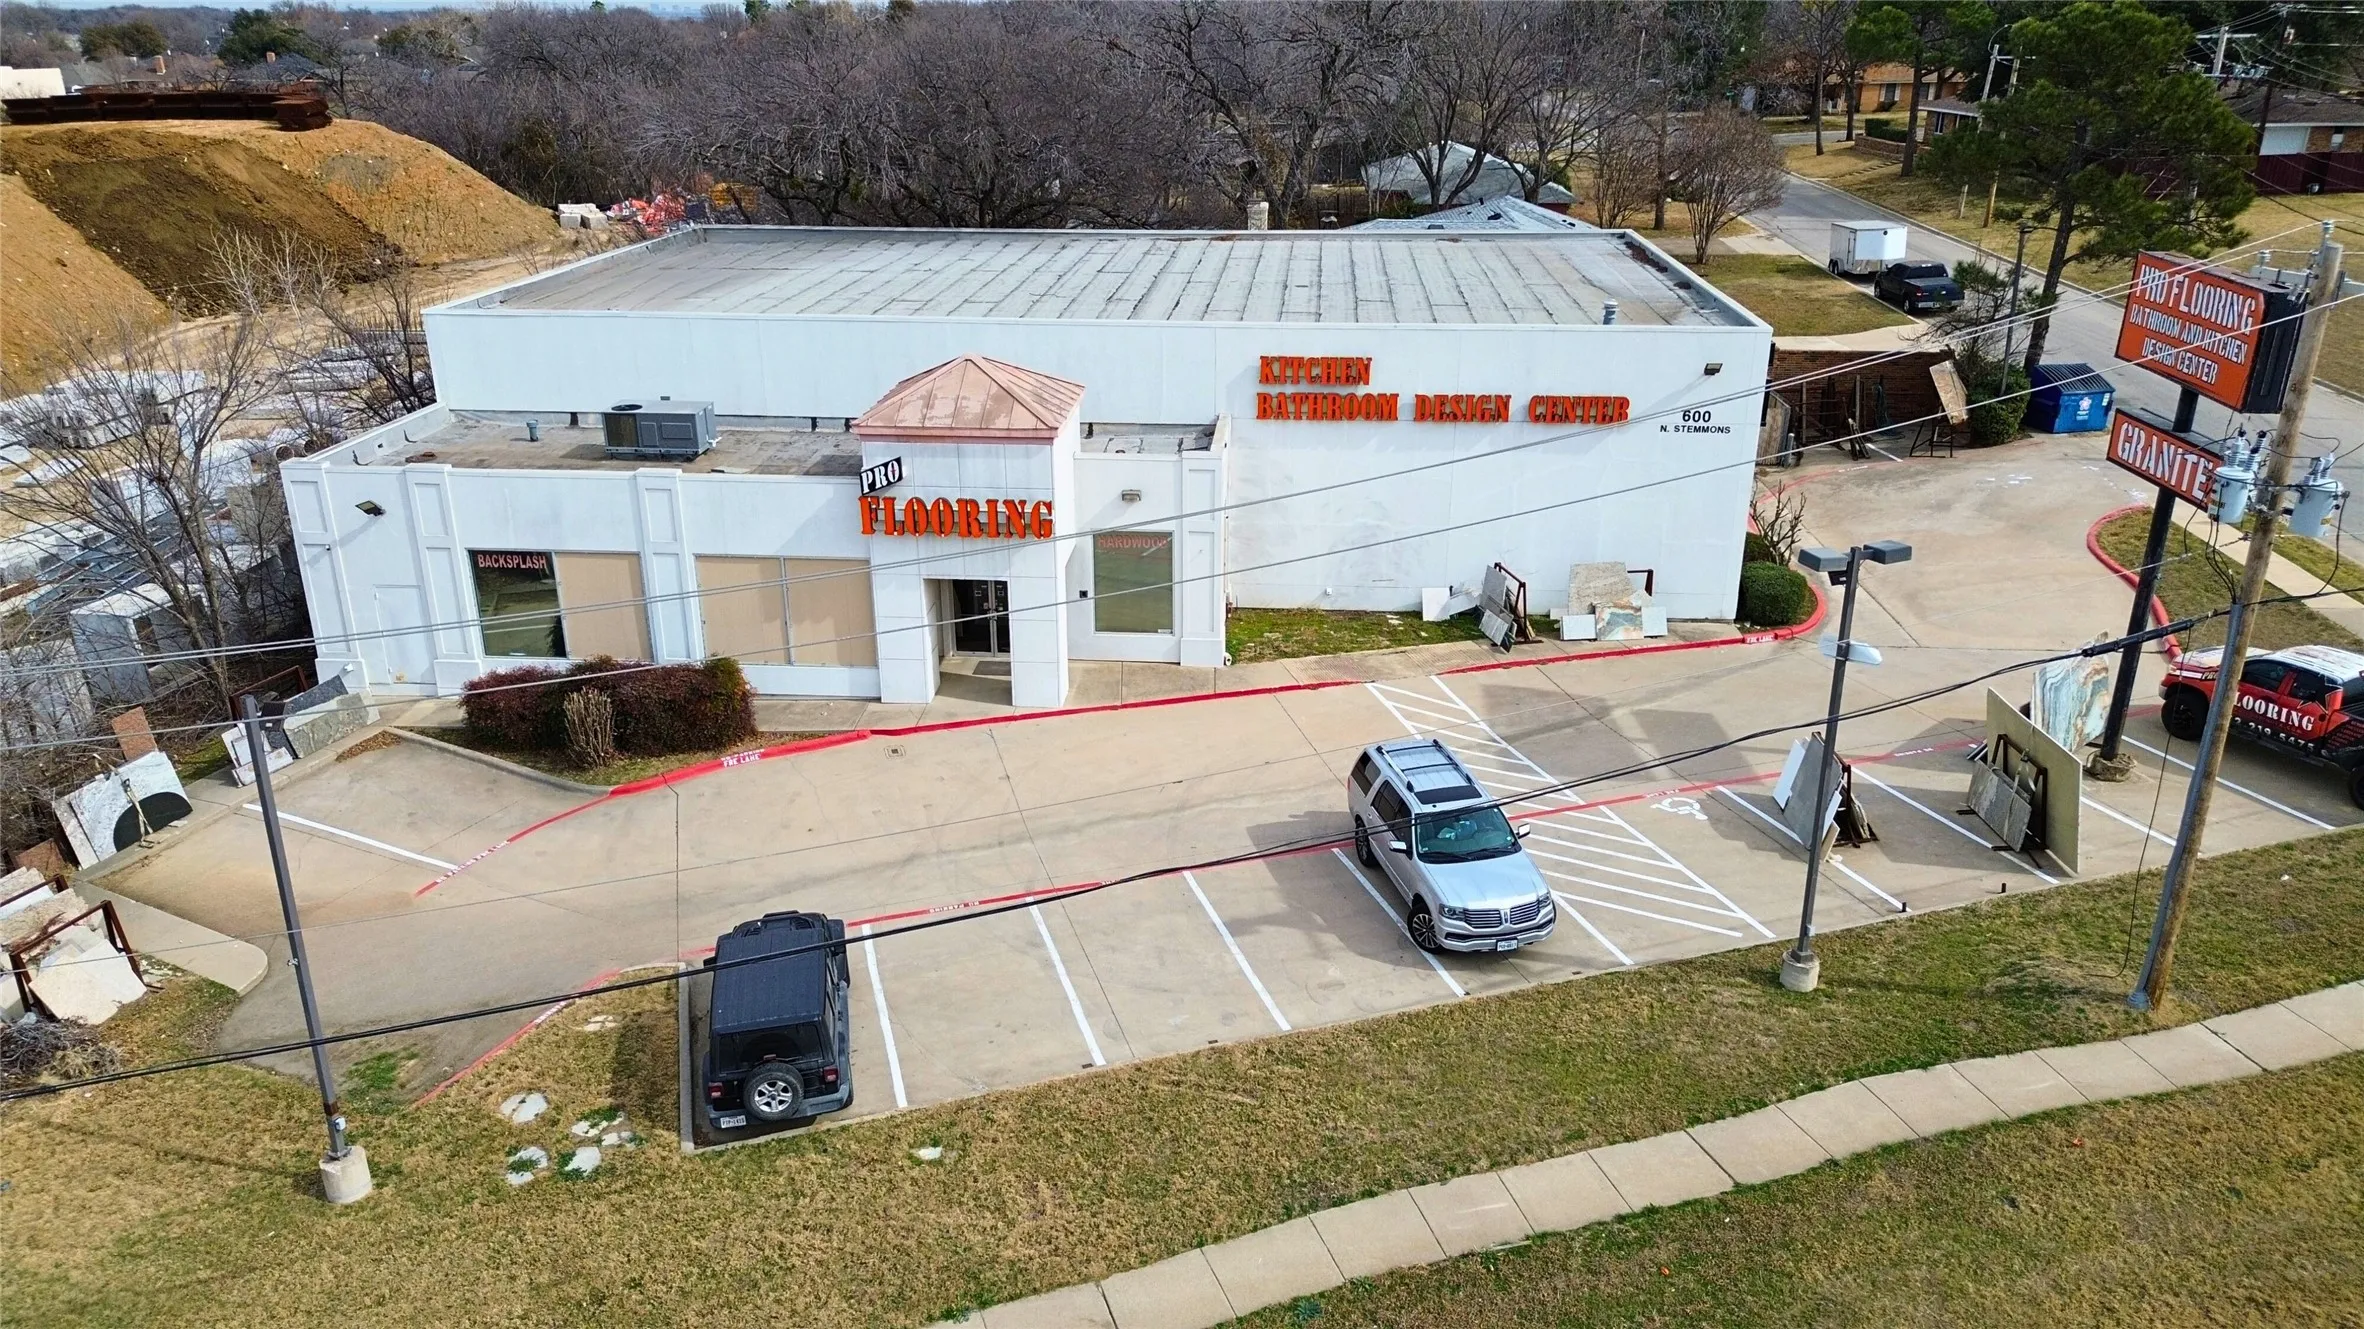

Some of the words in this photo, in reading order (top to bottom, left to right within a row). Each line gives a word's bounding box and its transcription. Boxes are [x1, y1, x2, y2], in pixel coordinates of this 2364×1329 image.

[2135, 264, 2170, 306] PRO
[2171, 274, 2256, 337] FLOORING
[2129, 304, 2181, 339] BATHROOM
[2179, 321, 2203, 345] AND
[2201, 331, 2248, 366] KITCHEN
[1259, 355, 1373, 386] KITCHEN
[2141, 337, 2177, 368] DESIGN
[2177, 352, 2219, 385] CENTER
[1256, 391, 1400, 422] BATHROOM
[1413, 394, 1512, 423] DESIGN
[1528, 395, 1630, 424] CENTER
[1681, 409, 1712, 424] 600
[1659, 424, 1670, 433] N.
[1673, 425, 1731, 435] STEMMONS
[860, 458, 901, 494] PRO
[2117, 421, 2213, 502] GRANITE
[857, 495, 1055, 540] FLOORING
[477, 554, 548, 569] BACKSPLASH
[2234, 691, 2315, 732] LOORING
